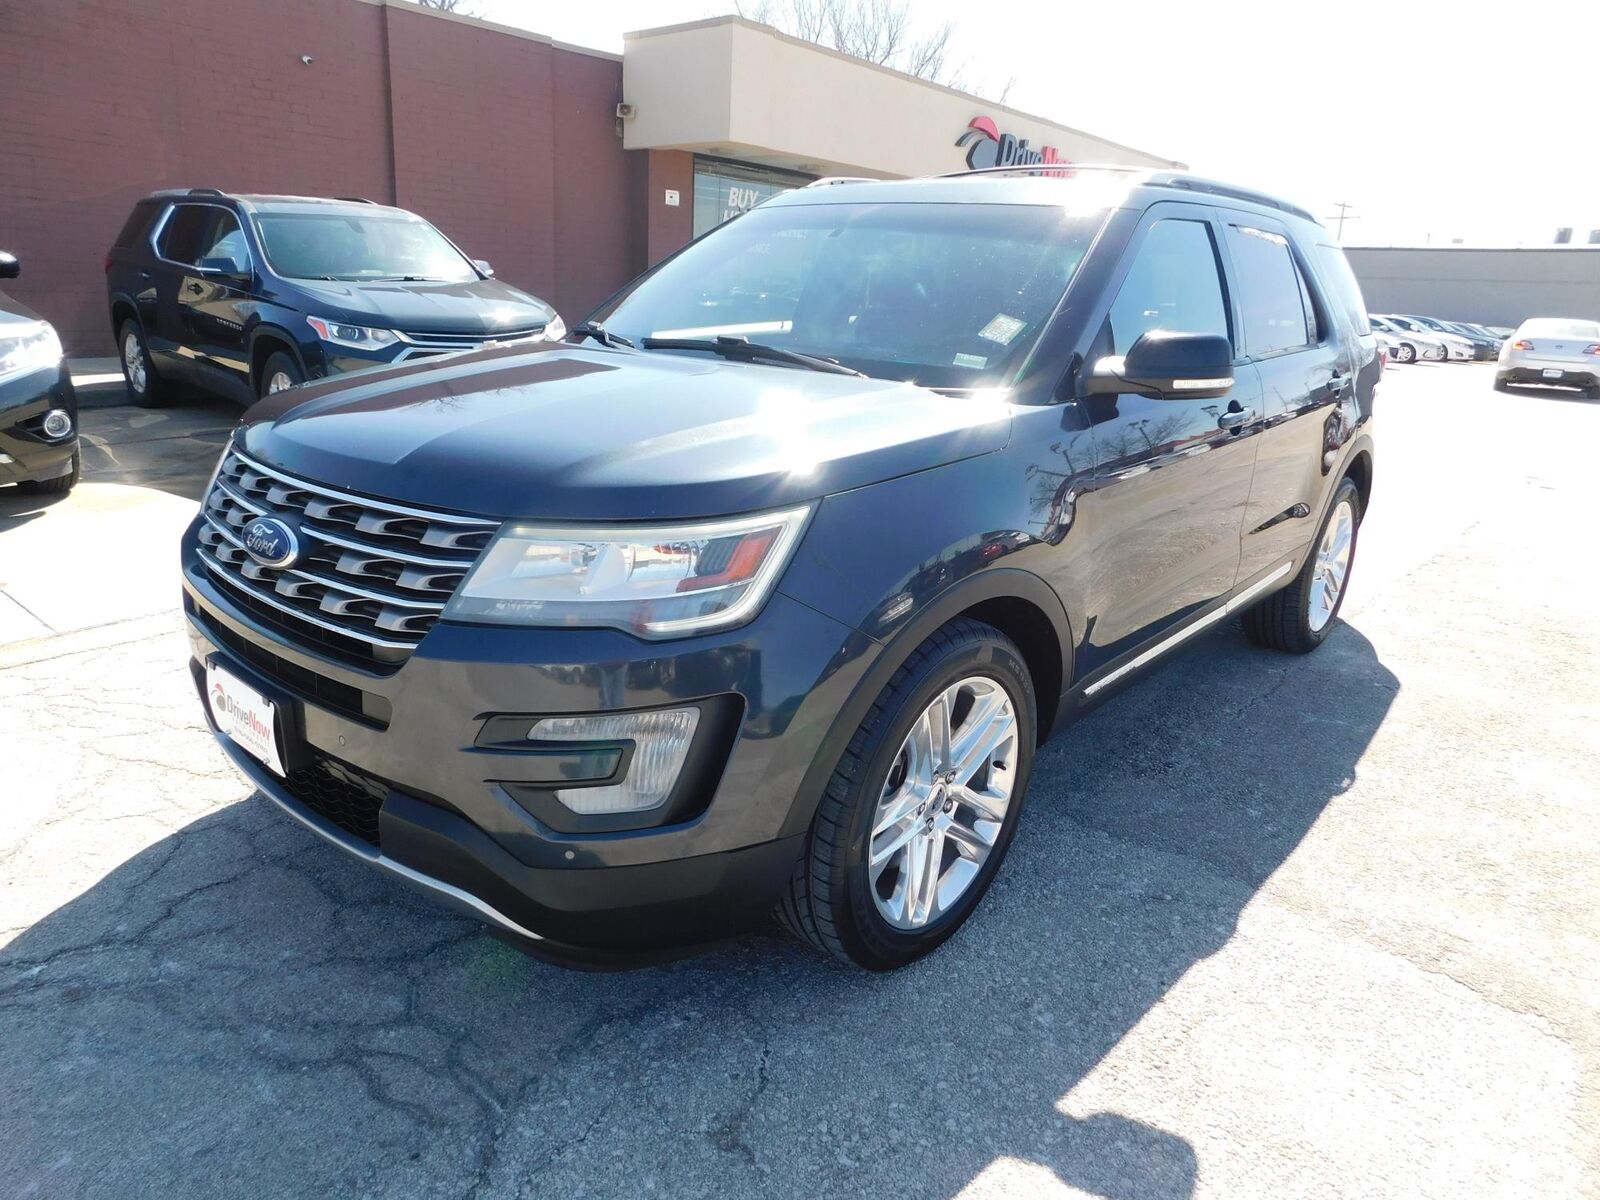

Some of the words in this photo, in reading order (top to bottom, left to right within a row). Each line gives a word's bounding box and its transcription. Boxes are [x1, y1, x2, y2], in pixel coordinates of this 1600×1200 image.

[728, 187, 759, 208] BUY
[247, 523, 279, 556] Ford
[226, 694, 271, 741] DriveNow
